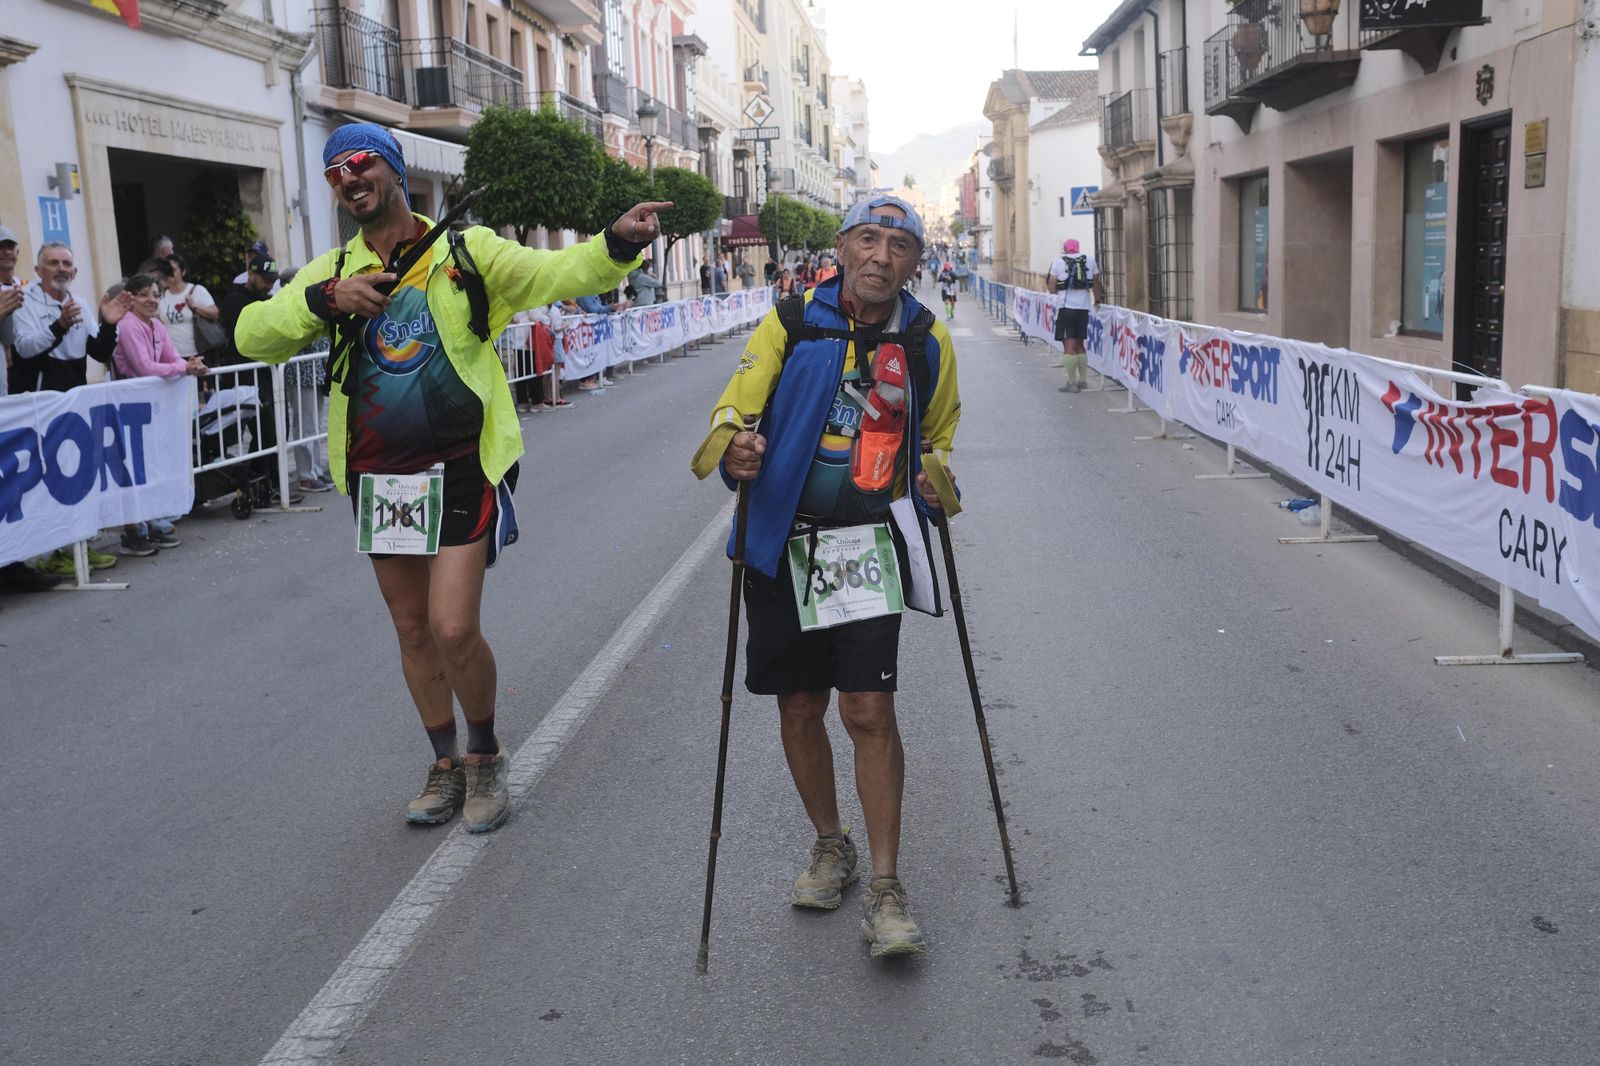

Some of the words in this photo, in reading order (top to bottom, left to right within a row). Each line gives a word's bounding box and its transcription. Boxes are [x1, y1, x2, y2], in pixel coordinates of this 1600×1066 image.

[115, 110, 168, 138] HOTEL
[171, 120, 255, 152] MAESTRANZA
[46, 201, 63, 231] H
[1188, 338, 1281, 405] INTERSPORT
[0, 402, 152, 524] PORT
[1325, 428, 1361, 491] 24H
[1418, 397, 1600, 532] INTERS
[375, 502, 424, 528] 1181
[836, 537, 861, 546] Unicaja
[1499, 508, 1567, 585] CARY
[811, 556, 882, 596] 3386
